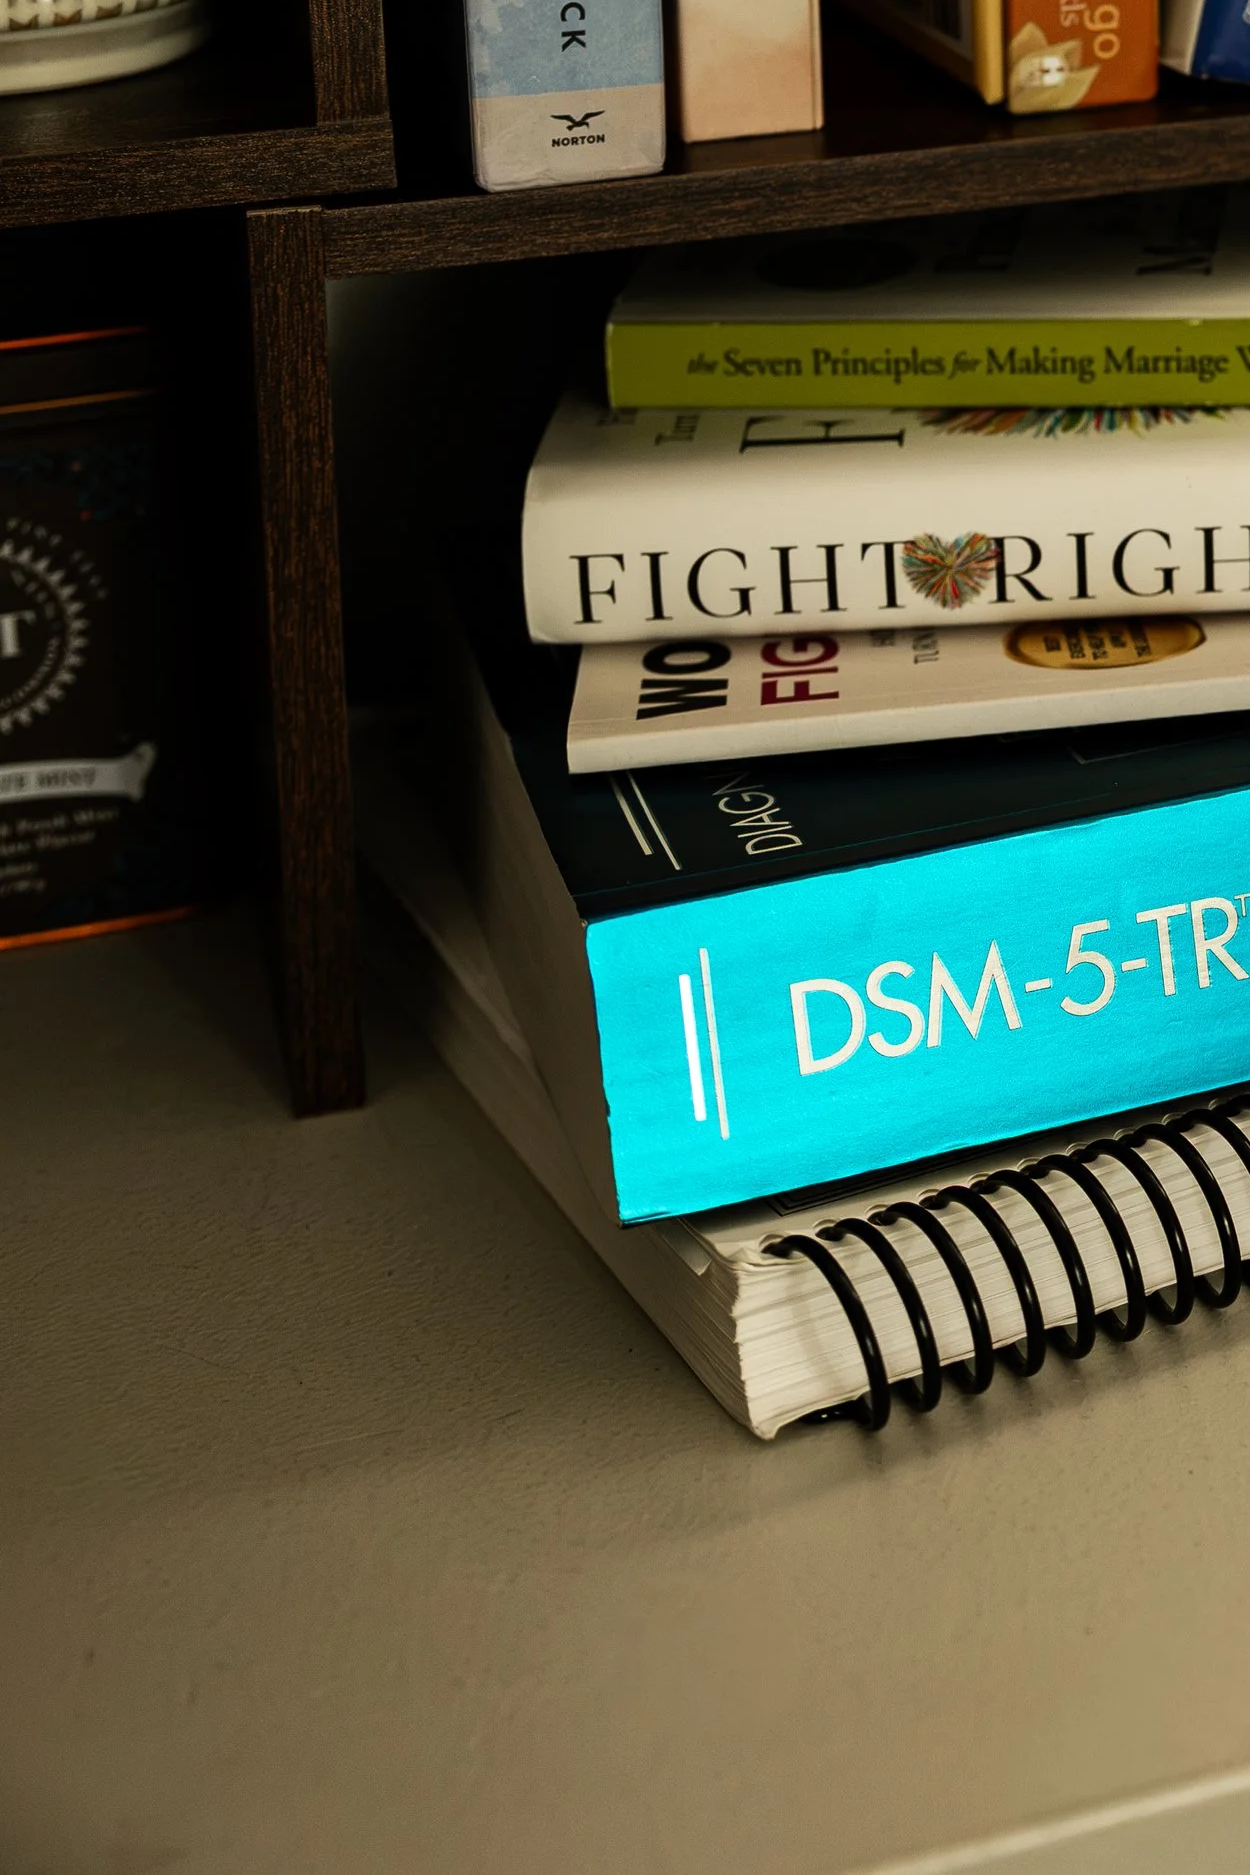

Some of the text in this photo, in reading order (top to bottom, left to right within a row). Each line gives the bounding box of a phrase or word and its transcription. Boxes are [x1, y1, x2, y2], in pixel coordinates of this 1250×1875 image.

[1083, 3, 1122, 61] go
[551, 133, 607, 149] NORTON
[686, 352, 719, 376] the
[723, 347, 803, 378] Seven
[811, 346, 947, 384] Principles
[948, 350, 982, 382] for
[985, 346, 1096, 384] Making
[1103, 345, 1229, 384] Marriage
[568, 538, 905, 626] FIGHT
